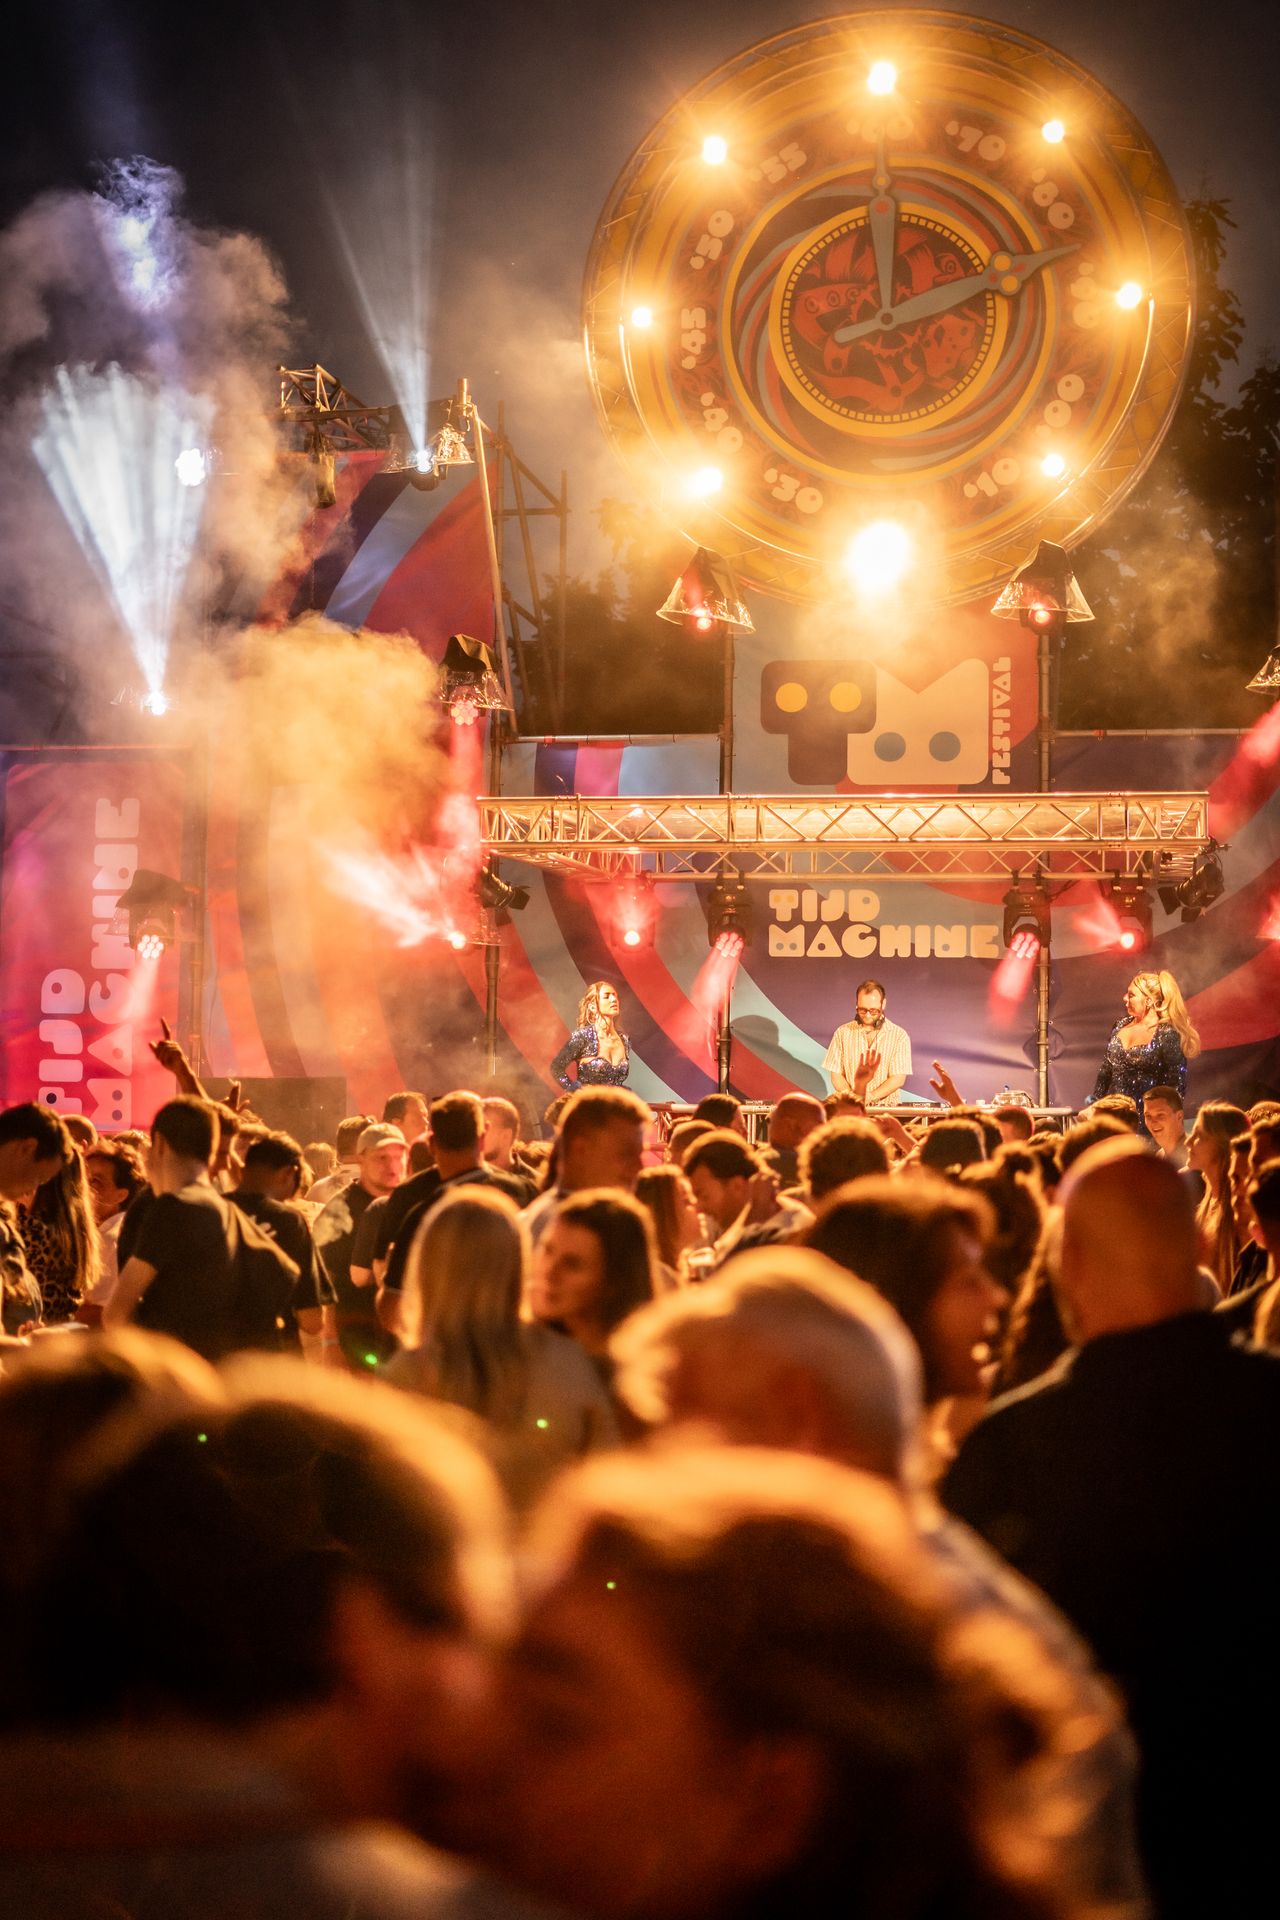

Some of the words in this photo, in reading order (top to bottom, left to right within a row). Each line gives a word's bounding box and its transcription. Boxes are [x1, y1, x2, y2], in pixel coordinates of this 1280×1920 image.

[992, 656, 1011, 784] FESTIVAL
[768, 889, 880, 922] TIJD
[768, 924, 999, 958] MACHINE
